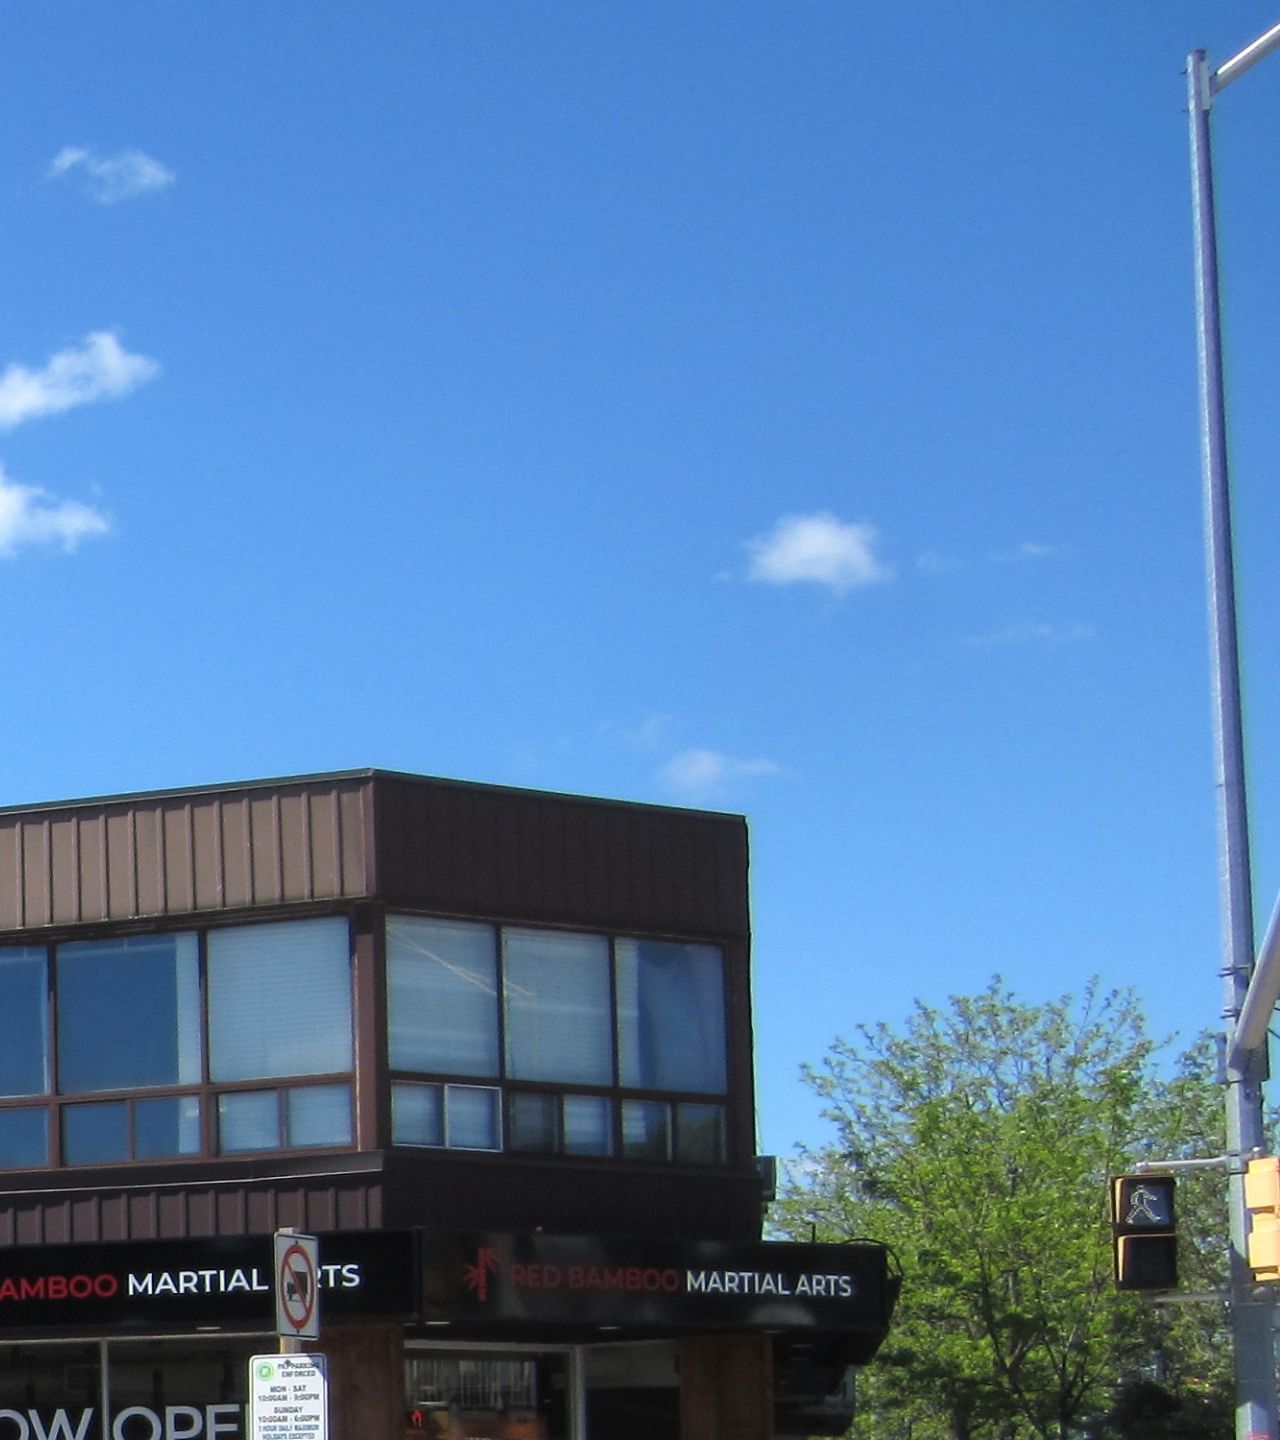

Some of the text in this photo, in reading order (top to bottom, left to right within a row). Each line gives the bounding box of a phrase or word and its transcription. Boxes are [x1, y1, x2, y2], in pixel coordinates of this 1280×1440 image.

[128, 1268, 268, 1295] MARTIAL
[316, 1264, 360, 1288] TS
[510, 1266, 852, 1298] RED BAMBOO MARTIAL ARTS
